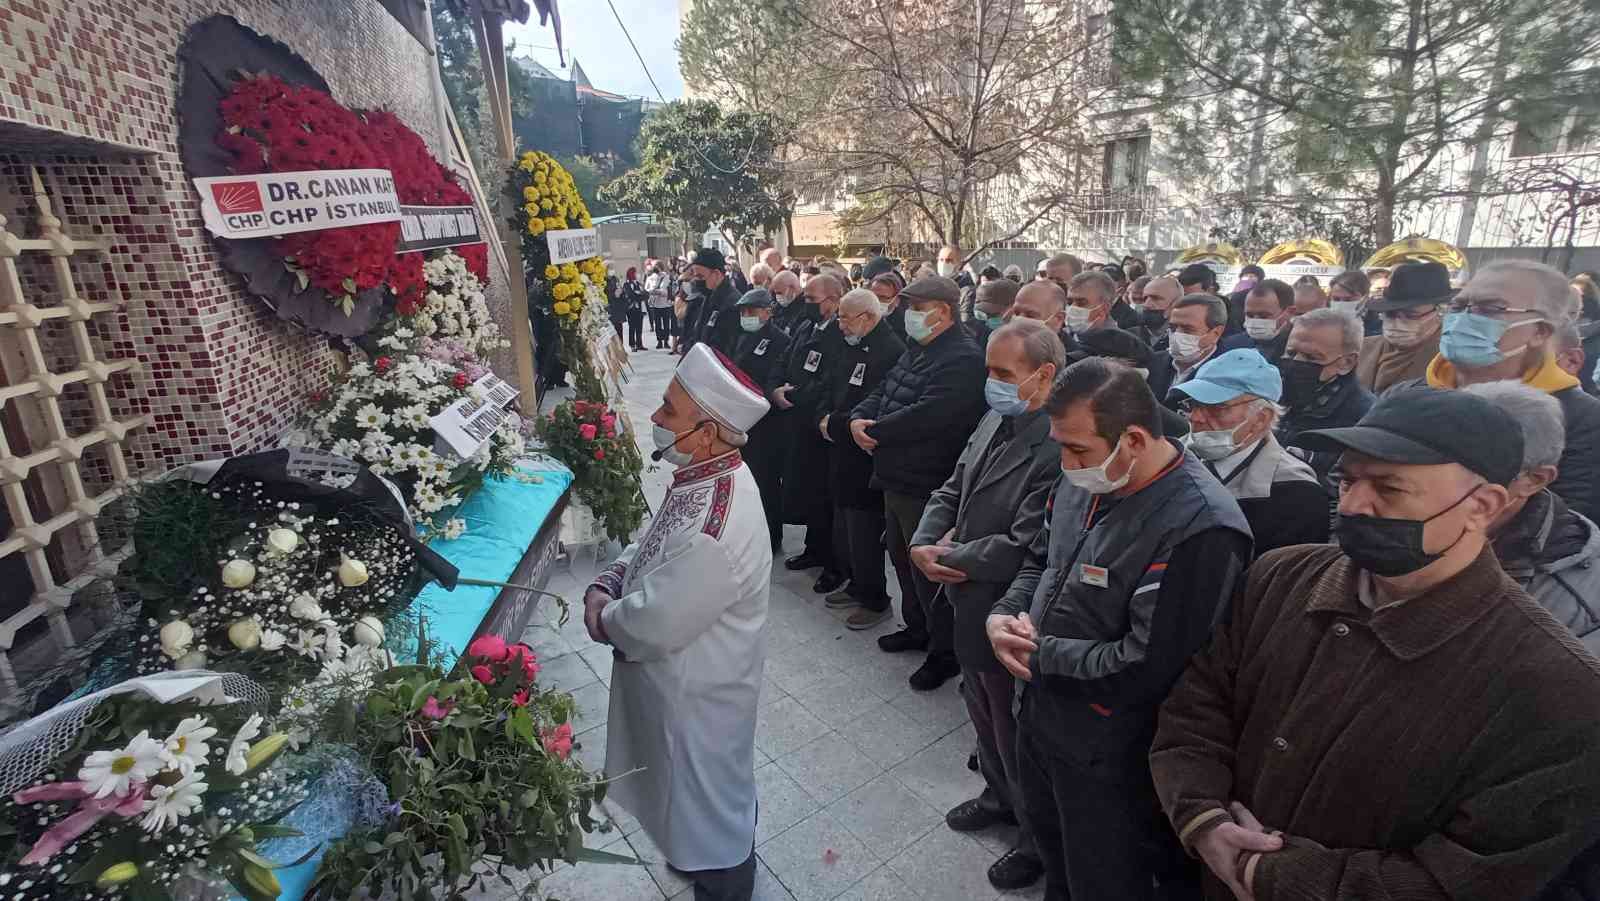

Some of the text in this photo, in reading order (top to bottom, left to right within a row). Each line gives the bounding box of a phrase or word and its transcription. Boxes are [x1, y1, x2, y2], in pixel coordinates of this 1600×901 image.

[373, 176, 394, 194] KAF
[228, 214, 263, 229] CHP
[270, 200, 397, 225] CHP İSTANBUL
